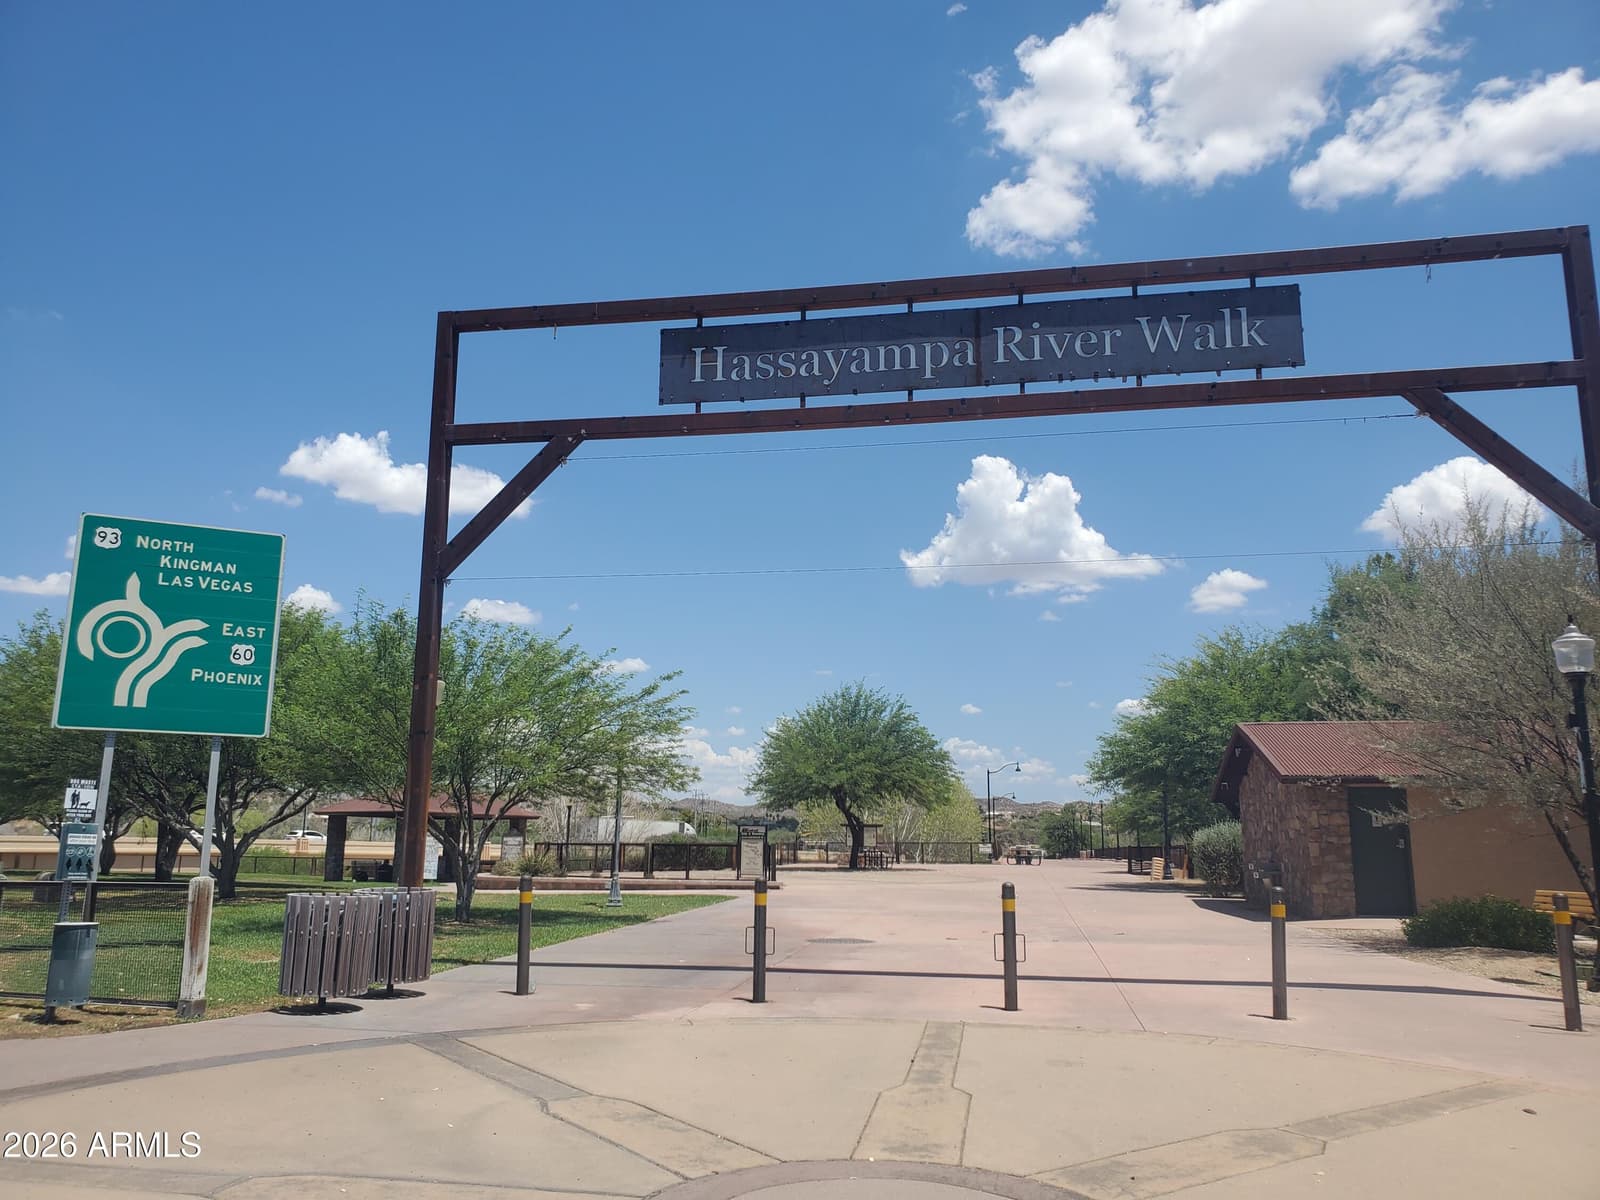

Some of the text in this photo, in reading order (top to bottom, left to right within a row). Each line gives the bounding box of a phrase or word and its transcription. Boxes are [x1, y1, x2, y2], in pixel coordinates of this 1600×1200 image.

[690, 307, 1270, 385] Hassayampa River Walk
[97, 530, 119, 545] 93
[135, 535, 194, 553] NORTH
[159, 555, 237, 575] KINGMAN
[158, 572, 253, 593] LAS VEGAS
[222, 623, 266, 639] EAST
[232, 648, 253, 661] 60
[191, 669, 262, 686] PHOENIX
